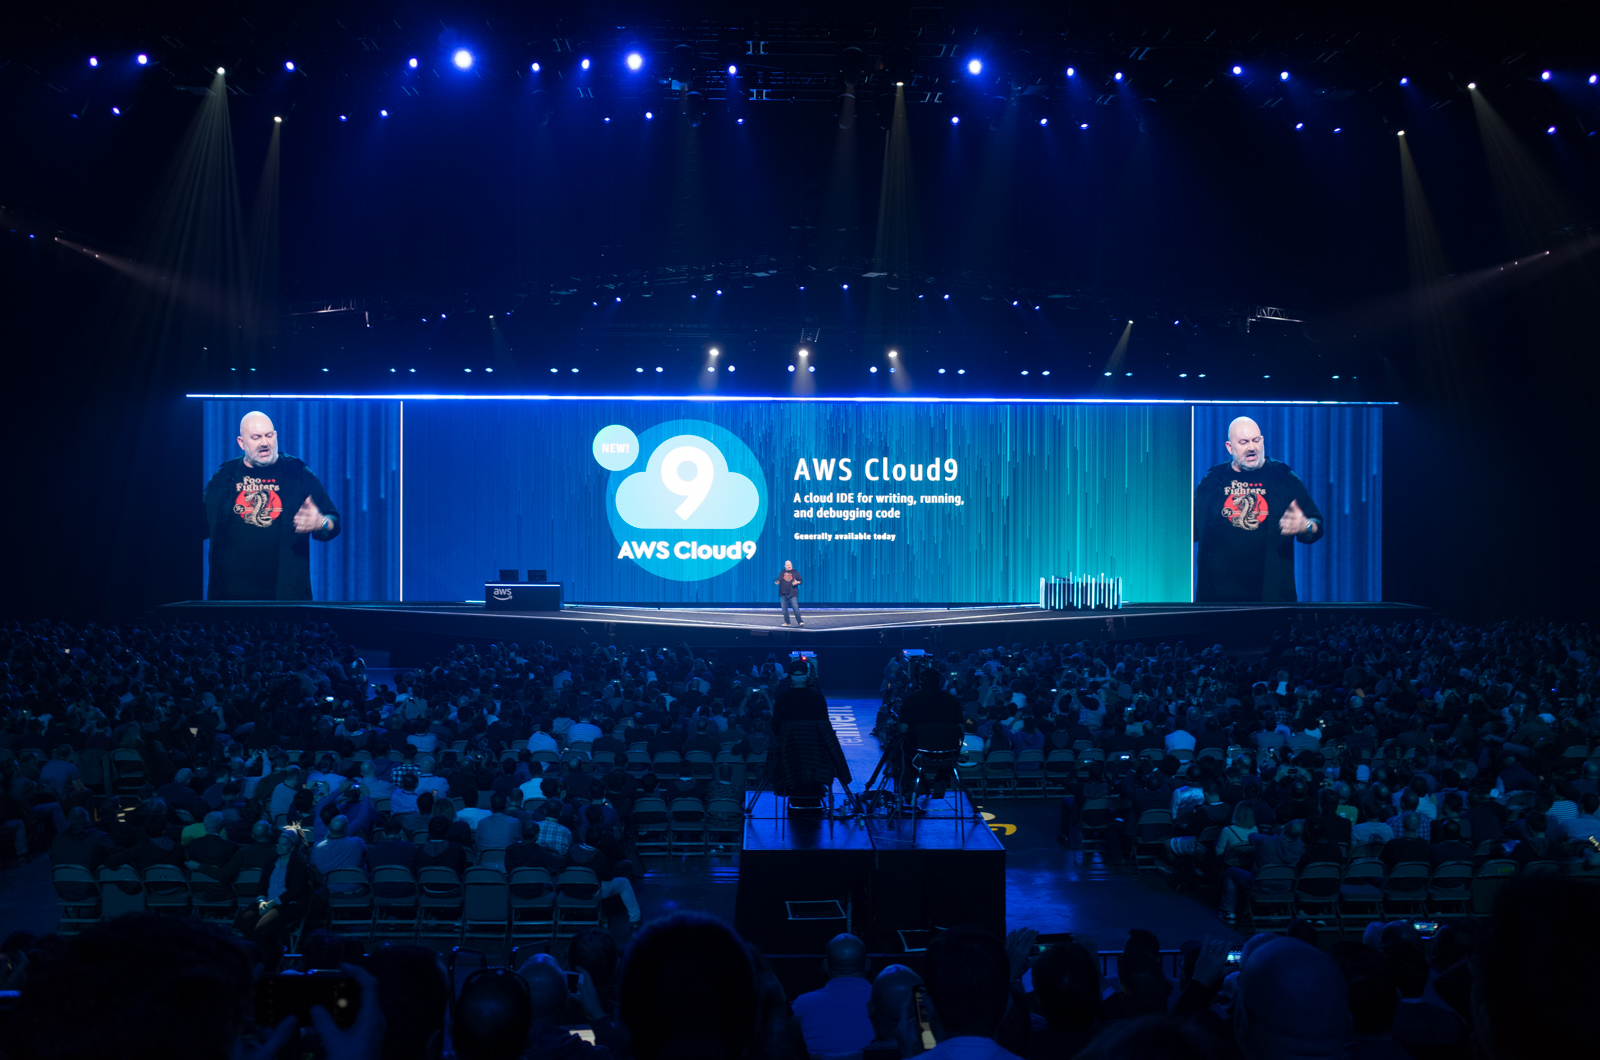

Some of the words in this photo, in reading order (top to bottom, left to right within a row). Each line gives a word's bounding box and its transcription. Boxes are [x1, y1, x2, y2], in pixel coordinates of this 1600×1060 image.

[601, 443, 630, 454] NEW!
[794, 458, 853, 481] AWS
[864, 457, 959, 481] Cloud9
[243, 476, 261, 484] Foo
[660, 446, 715, 522] 9
[1231, 480, 1249, 489] Foo
[793, 493, 802, 503] A
[804, 492, 833, 504] cloud
[836, 493, 854, 503] IDE
[857, 492, 873, 503] for
[876, 493, 917, 506] writing,
[920, 493, 964, 506] running,
[793, 507, 814, 518] and
[816, 507, 873, 521] debugging
[875, 507, 901, 518] code
[794, 532, 832, 541] Generally
[834, 532, 872, 540] available
[873, 532, 896, 541] today
[617, 541, 671, 560] AWS
[673, 541, 757, 560] Cloud9
